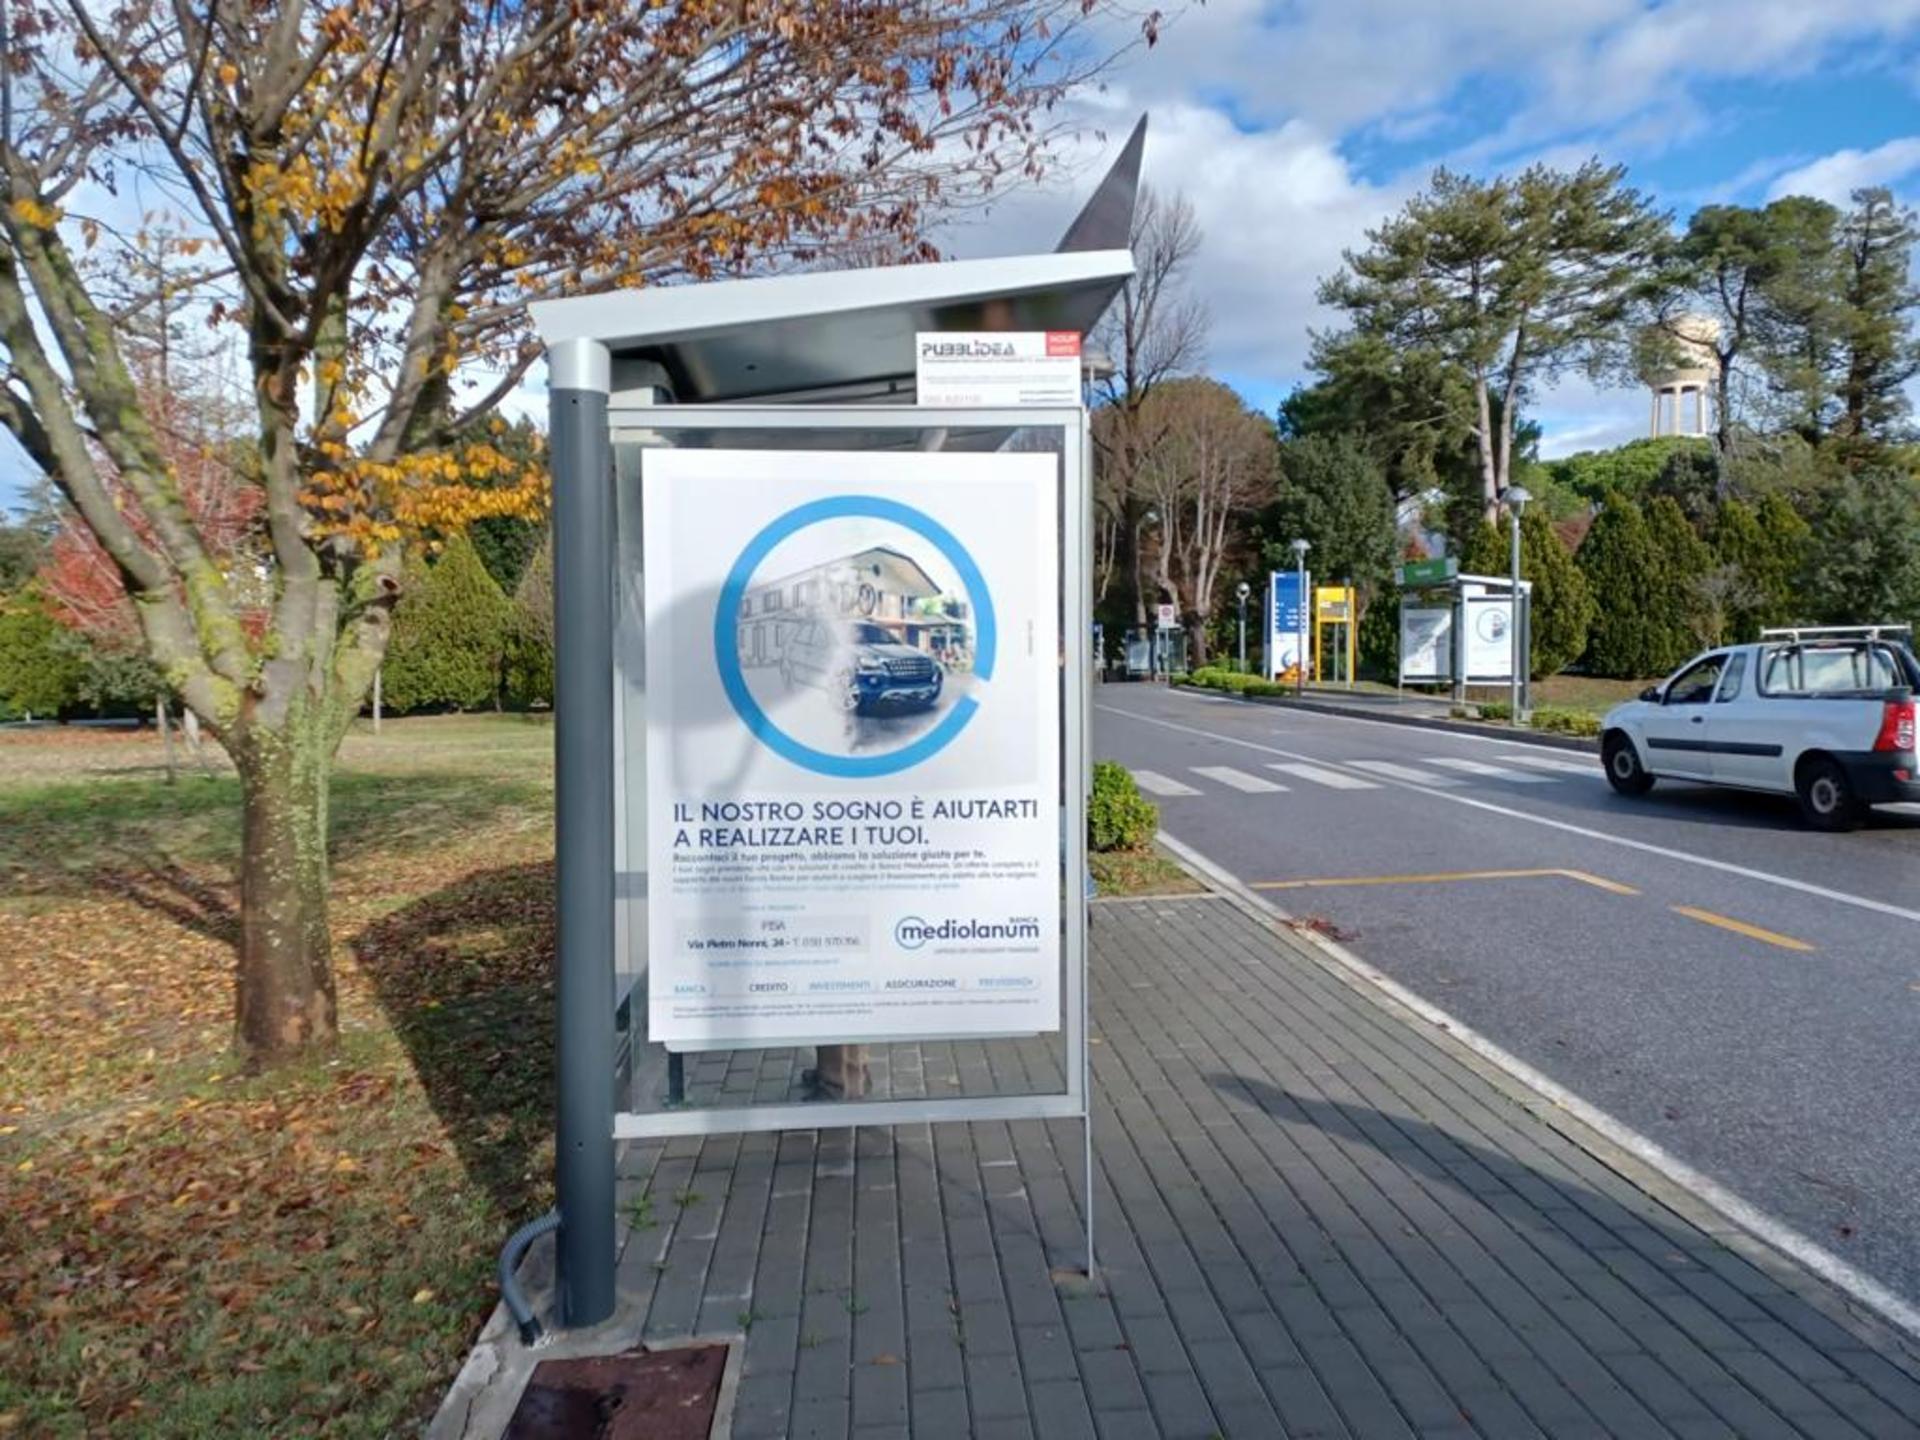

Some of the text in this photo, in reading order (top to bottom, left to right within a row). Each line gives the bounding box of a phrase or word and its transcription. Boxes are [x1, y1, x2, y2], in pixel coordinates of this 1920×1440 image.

[674, 796, 1039, 822] IL NOSTRO SOGNO È AIUTARTI
[674, 825, 929, 847] A REALIZZARE I TUOI.
[741, 852, 758, 862] tuo
[761, 851, 805, 864] progetto,
[811, 851, 856, 861] abbiamo
[872, 850, 918, 861] soluzione
[920, 849, 951, 862] giusta
[954, 850, 971, 861] per
[973, 849, 987, 859] te.
[901, 919, 1039, 940] mediolanum
[687, 938, 704, 949] Via
[748, 982, 788, 992] CREDITO
